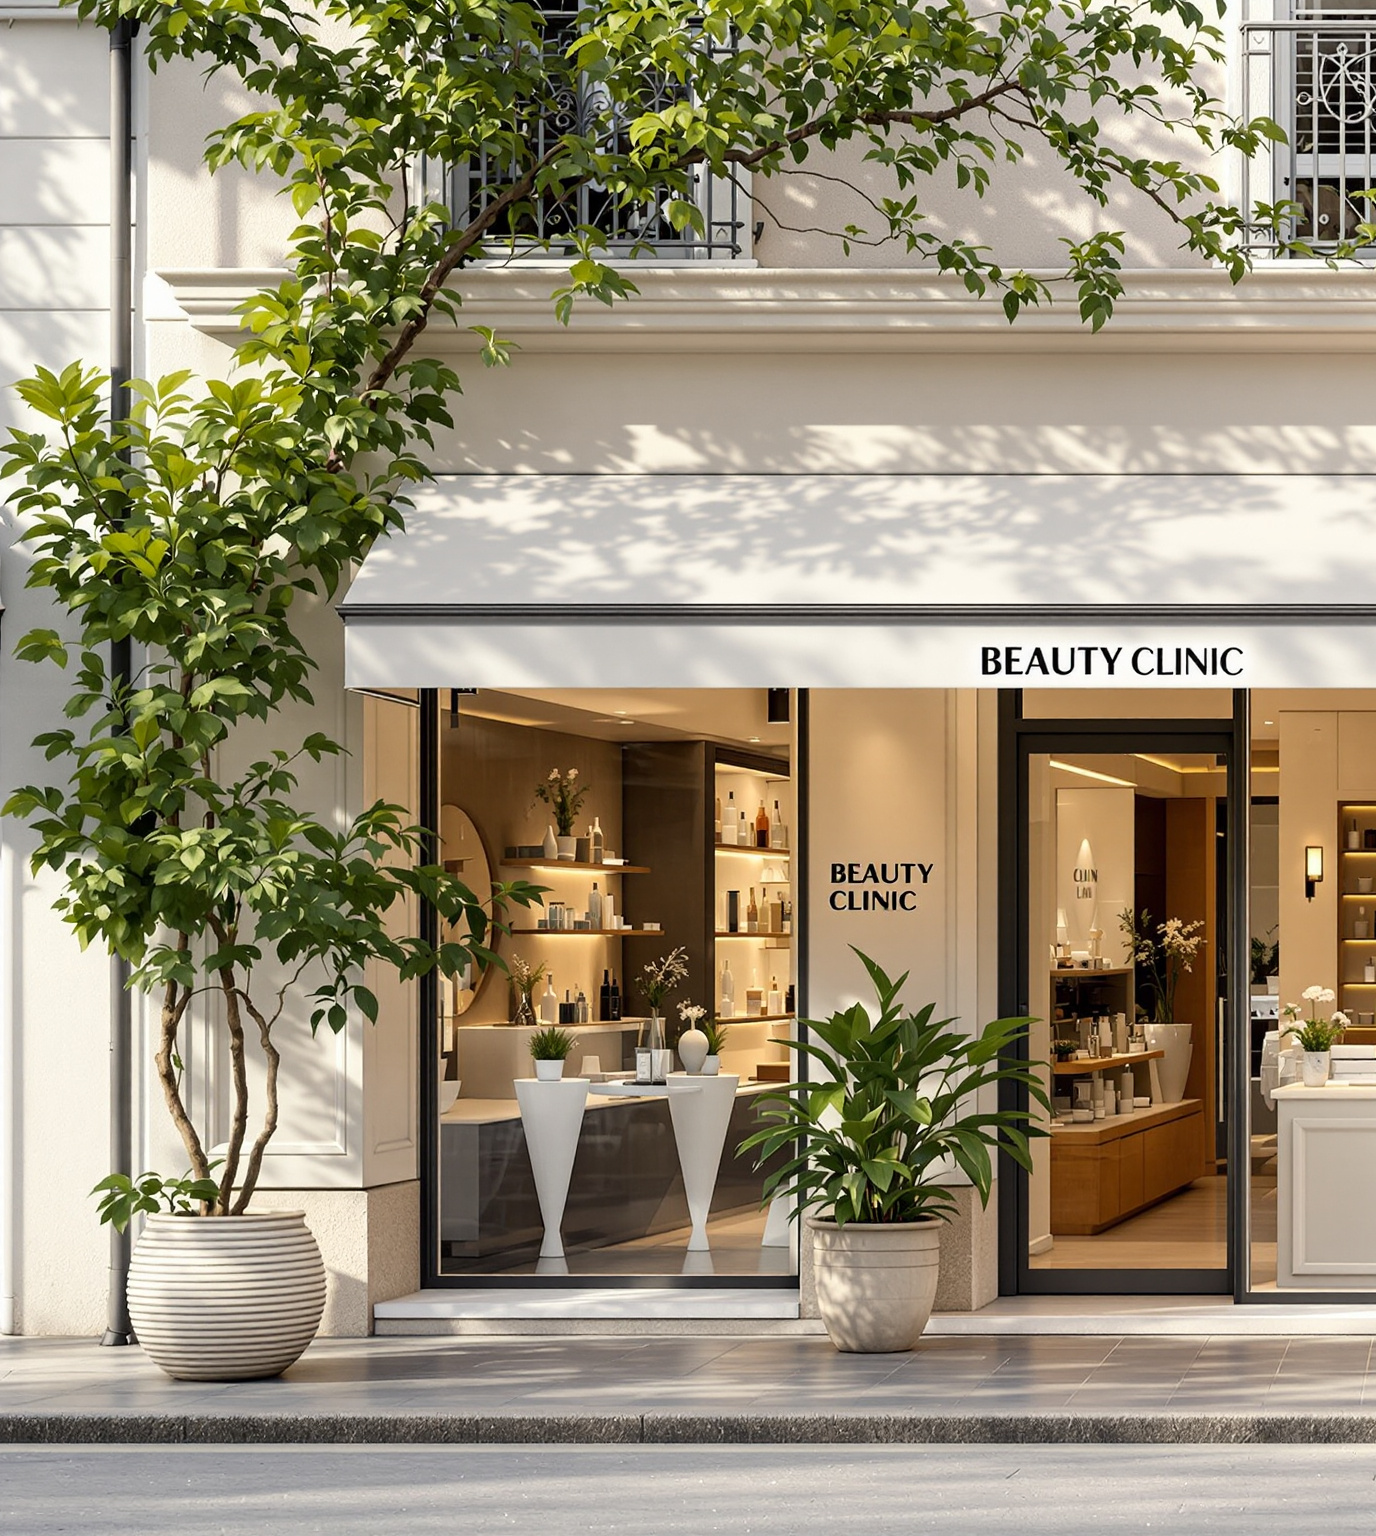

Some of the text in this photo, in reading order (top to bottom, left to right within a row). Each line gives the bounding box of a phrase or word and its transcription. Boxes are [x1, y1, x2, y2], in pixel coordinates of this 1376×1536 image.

[982, 646, 1244, 676] BEAUTY CLINIC
[830, 863, 934, 884] BEAUTY
[829, 890, 917, 911] CLINIC
